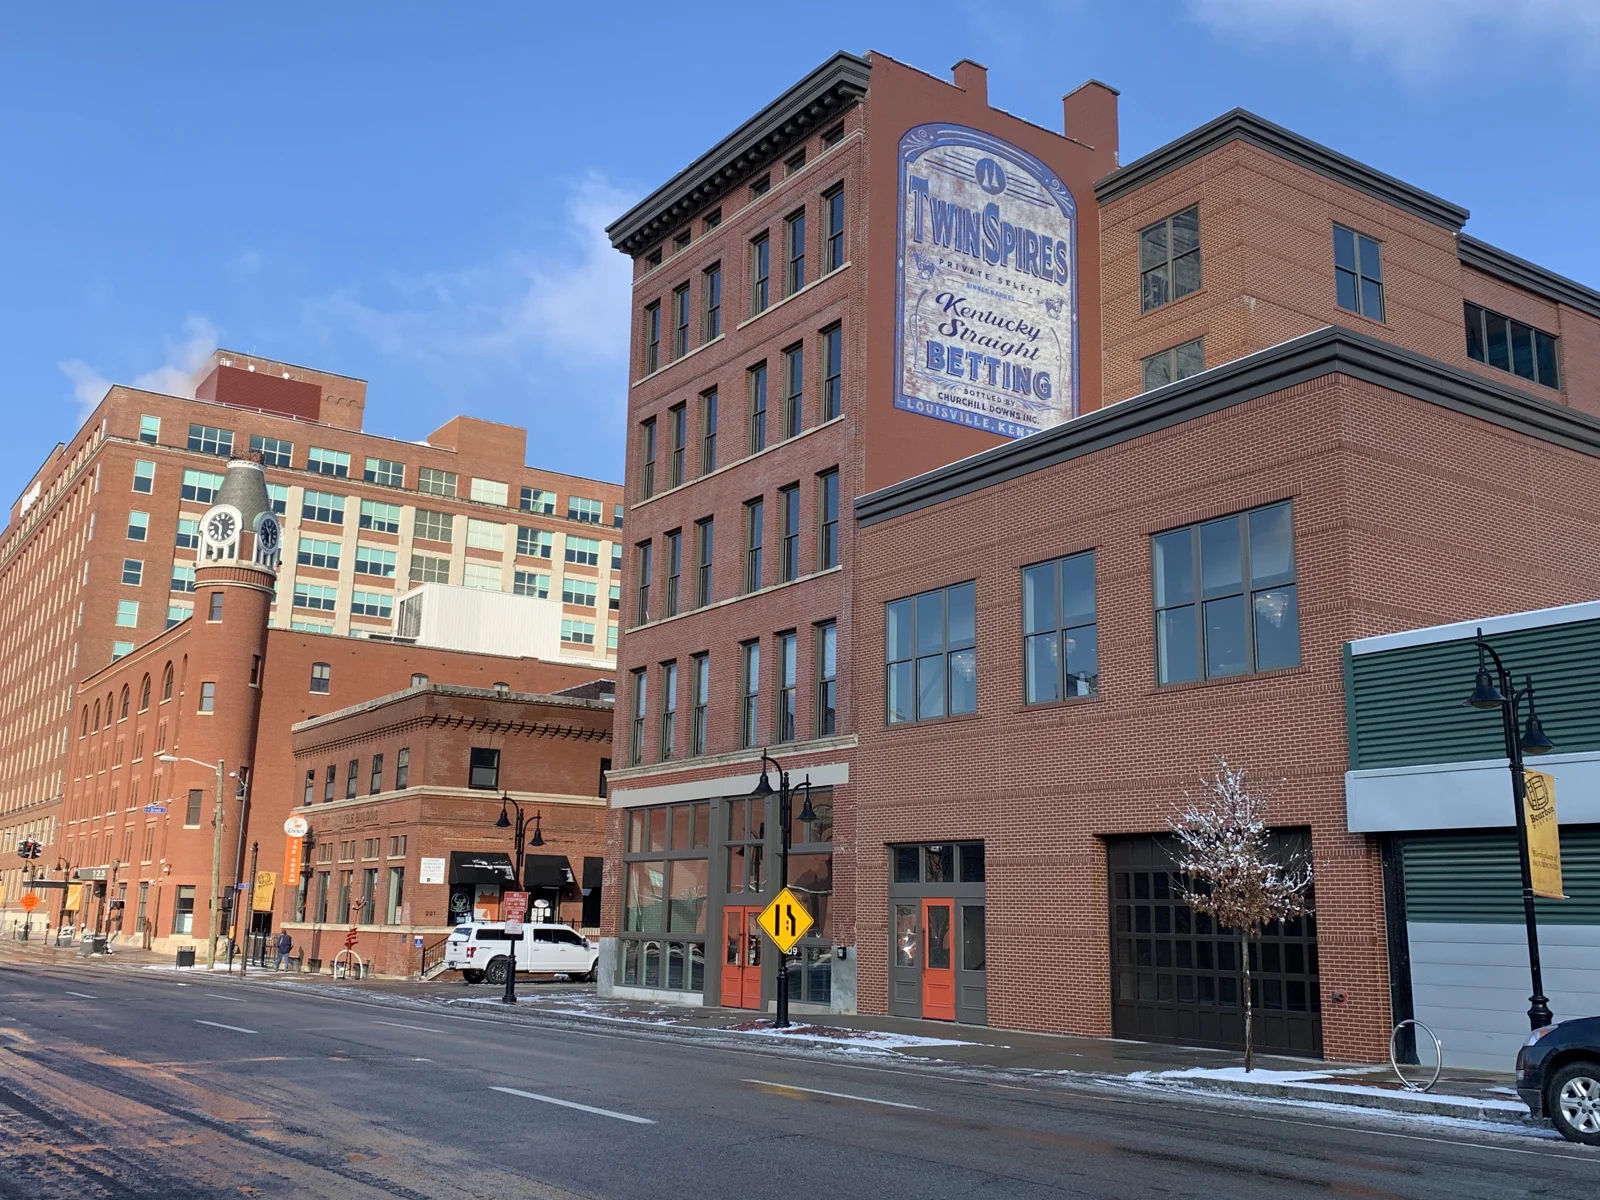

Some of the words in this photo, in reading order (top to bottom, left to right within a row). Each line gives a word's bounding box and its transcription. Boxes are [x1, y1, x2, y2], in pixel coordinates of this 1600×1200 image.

[939, 258, 991, 280] PRIVATE
[998, 277, 1041, 296] SELECT
[966, 282, 989, 294] SINGLE
[990, 288, 1016, 302] BARREL
[935, 292, 1041, 342] Kentucky
[938, 318, 1041, 361] Straight
[926, 339, 1052, 401] BETTING
[938, 392, 987, 411] CHURCHILL
[989, 404, 1021, 420] DOWNS
[1023, 413, 1041, 425] INC.
[963, 388, 1002, 402] BOTTLED
[1005, 399, 1016, 407] BY
[906, 398, 994, 430] LOUISVILLE,
[1530, 806, 1555, 823] Bourbon
[92, 869, 106, 877] 123
[288, 858, 297, 883] CREAM
